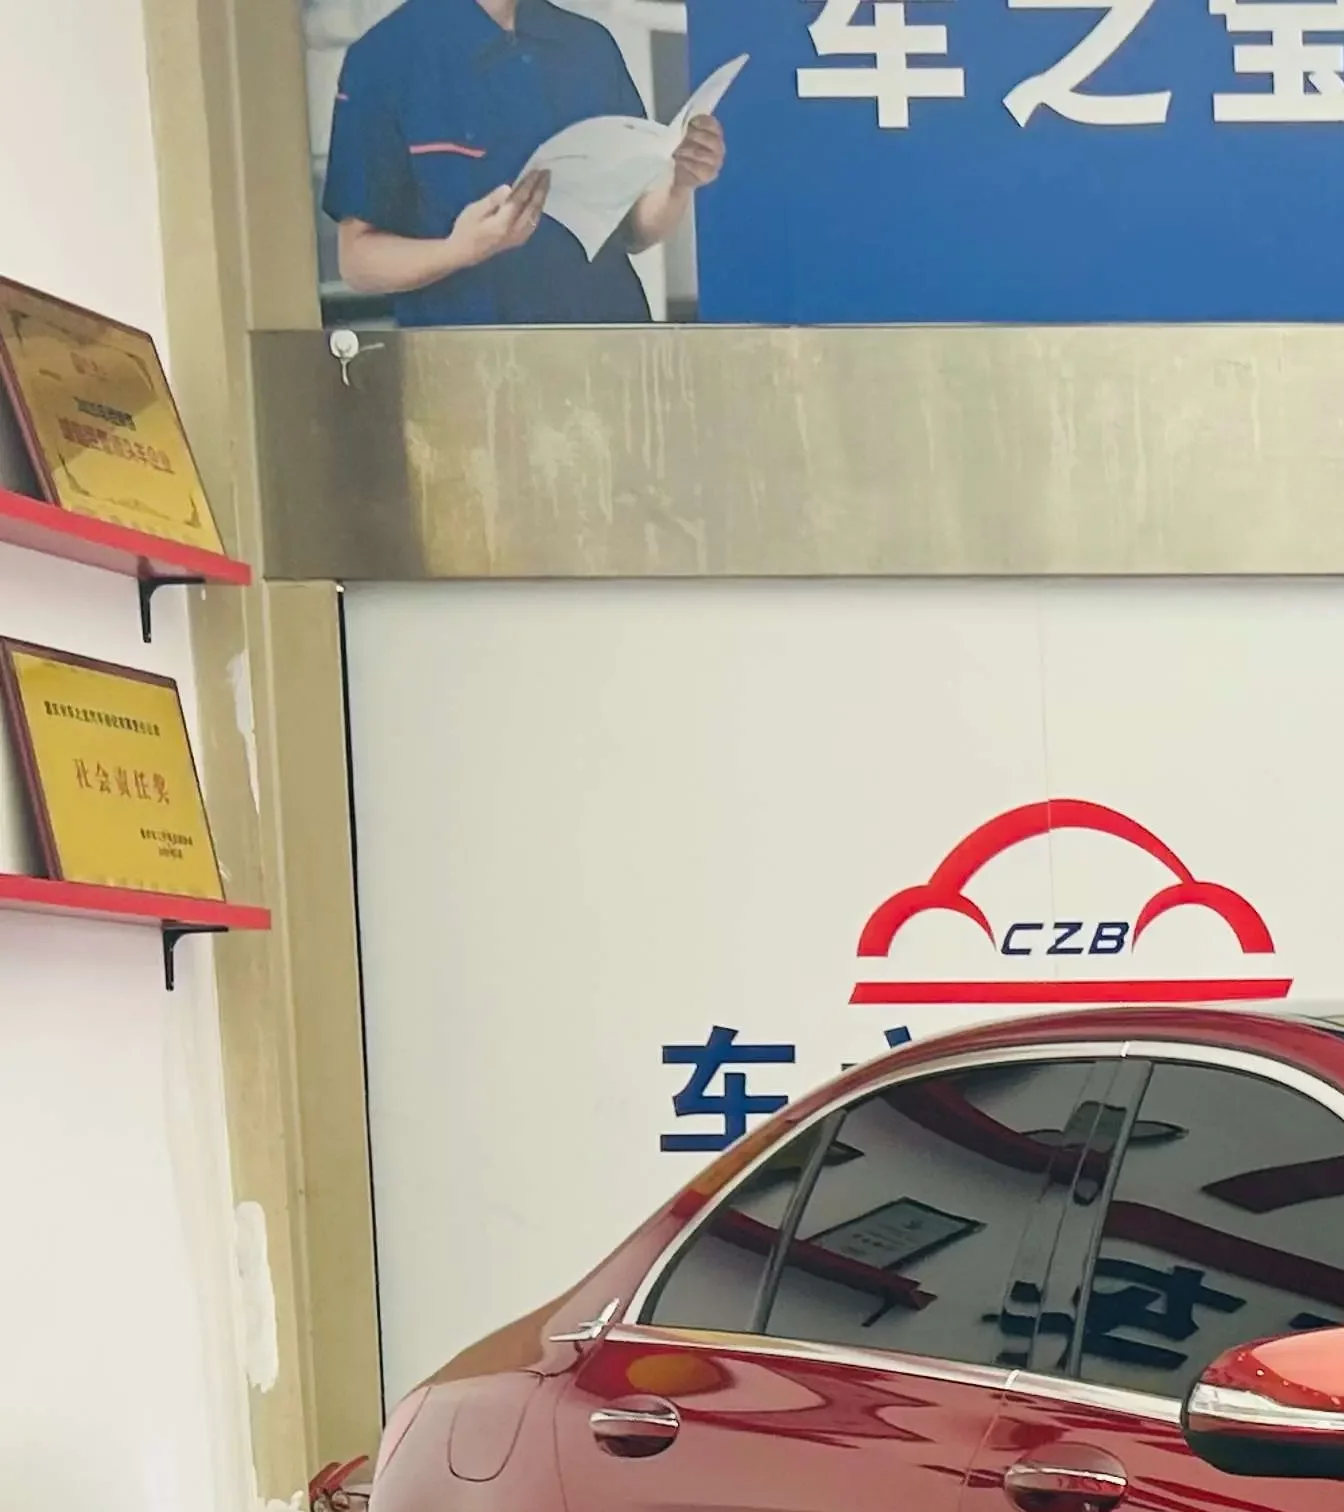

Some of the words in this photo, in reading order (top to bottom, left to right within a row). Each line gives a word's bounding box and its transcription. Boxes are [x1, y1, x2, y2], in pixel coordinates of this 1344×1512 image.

[73, 757, 170, 805] 社会责任奖
[1000, 921, 1130, 956] CZB
